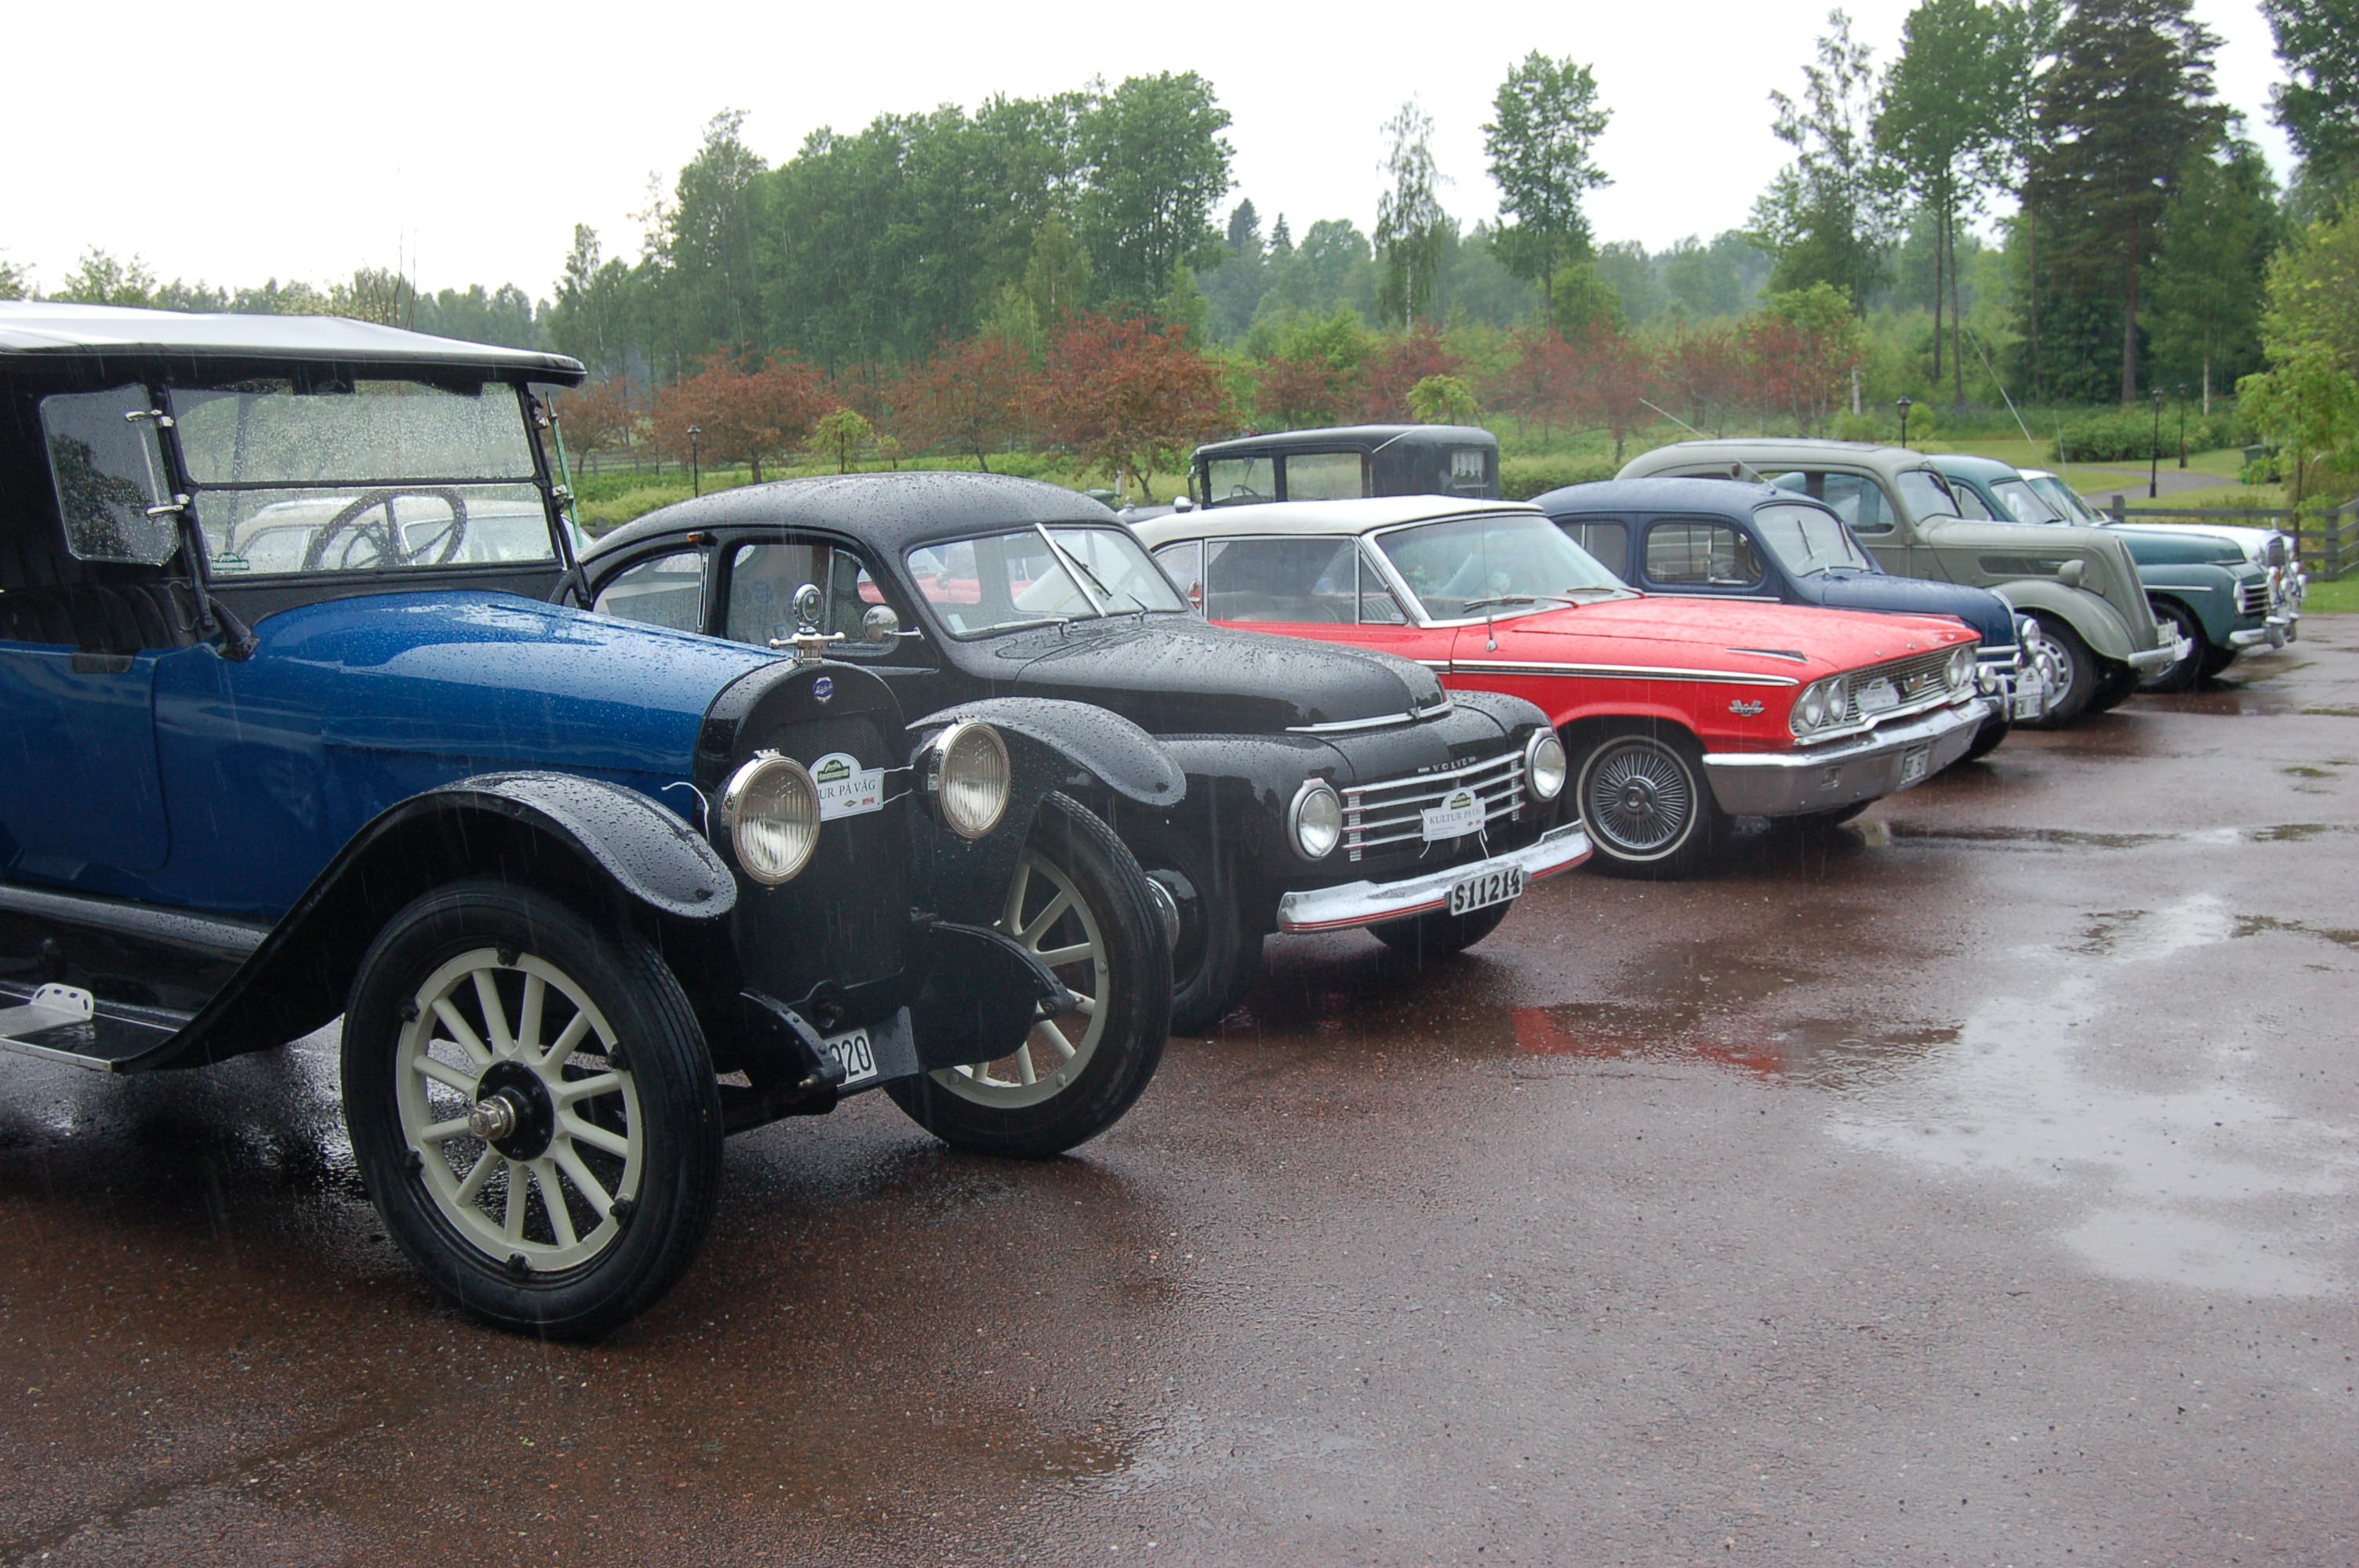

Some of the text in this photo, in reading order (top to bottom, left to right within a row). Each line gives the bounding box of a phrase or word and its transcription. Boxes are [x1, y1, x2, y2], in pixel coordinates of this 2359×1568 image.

[1433, 758, 1467, 772] VOLVO
[839, 782, 852, 796] PÅ
[1430, 812, 1462, 825] KULTUR
[1454, 868, 1520, 912] S11214
